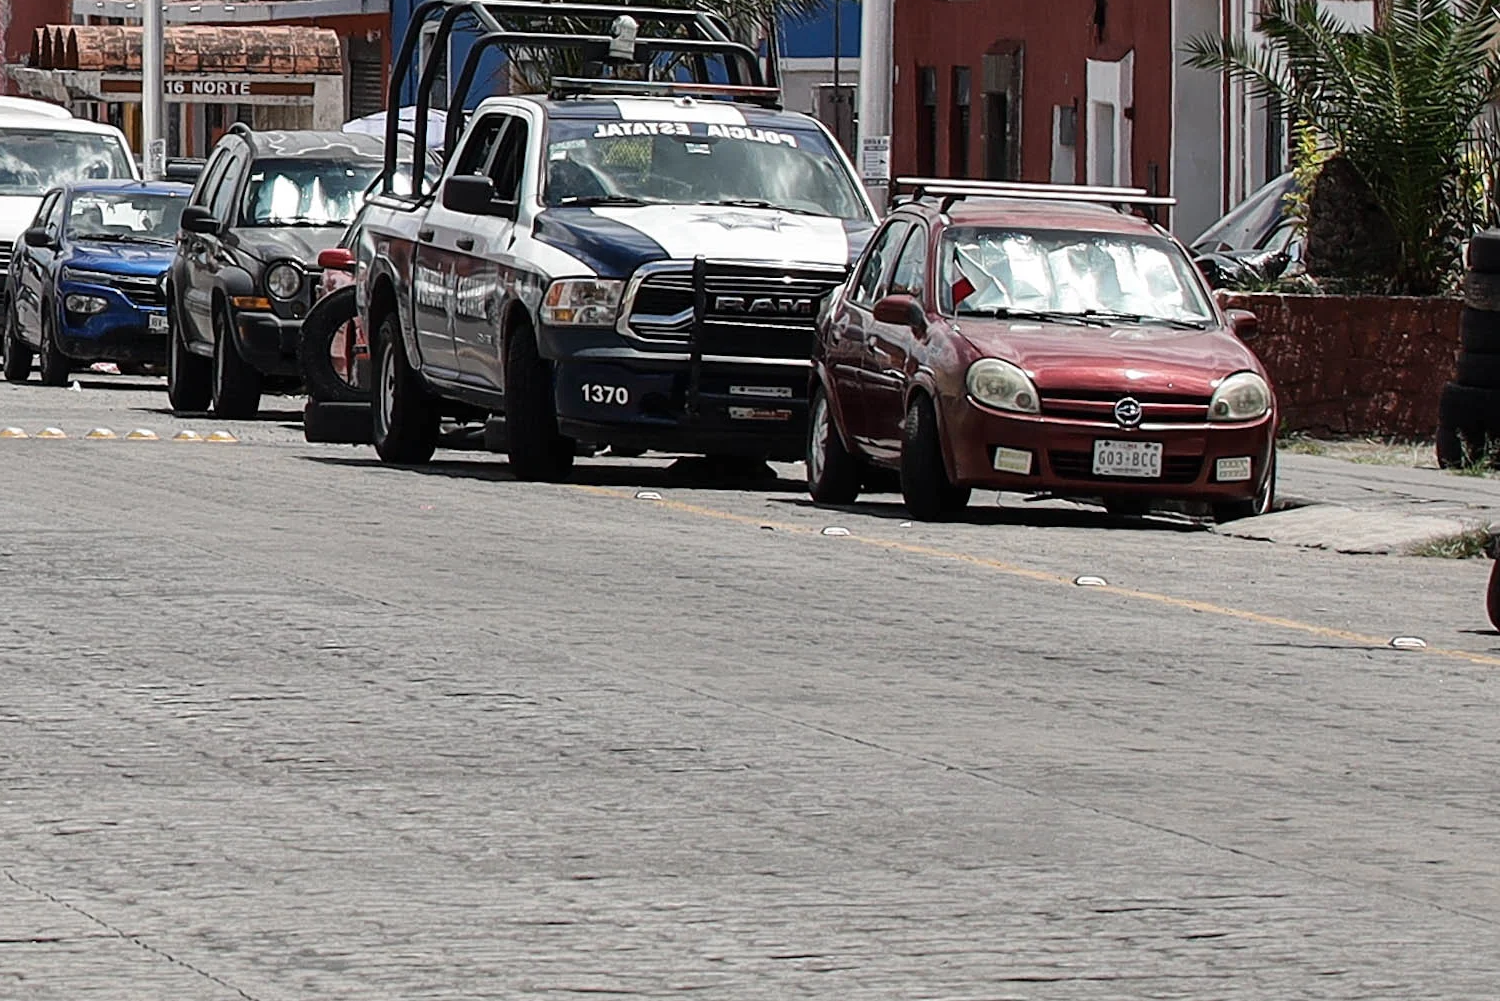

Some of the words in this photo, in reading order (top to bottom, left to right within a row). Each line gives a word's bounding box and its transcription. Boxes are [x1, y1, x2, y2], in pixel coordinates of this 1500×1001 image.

[165, 81, 185, 94] 16
[191, 81, 251, 95] NORTE
[714, 296, 812, 313] RAM
[581, 384, 629, 405] 1370
